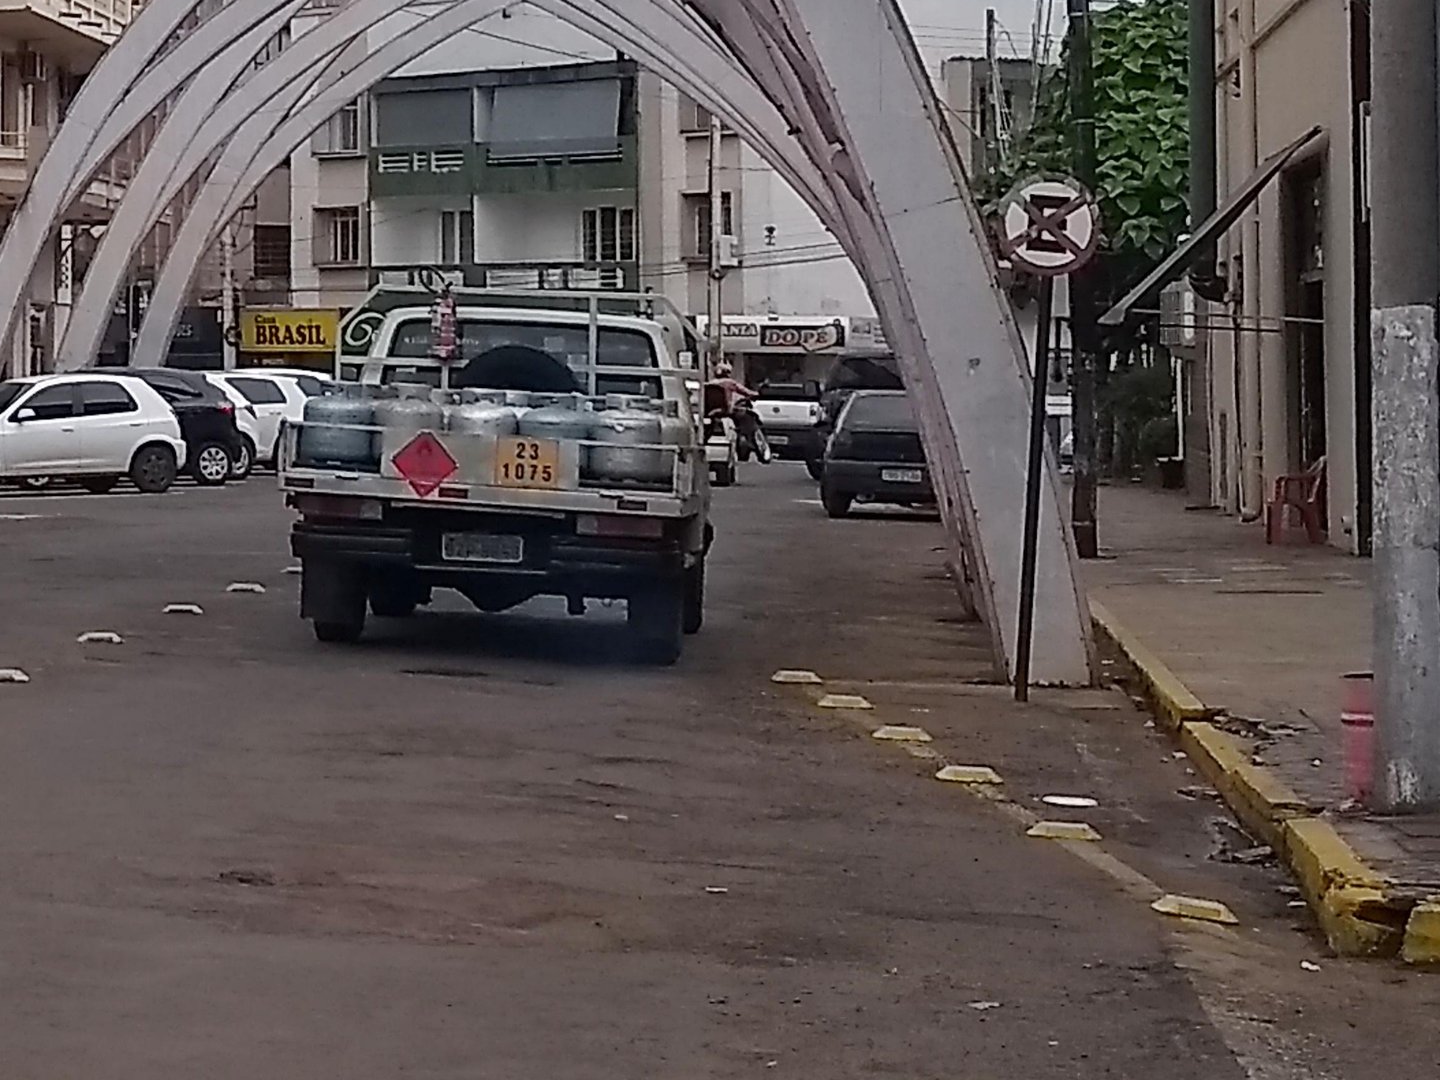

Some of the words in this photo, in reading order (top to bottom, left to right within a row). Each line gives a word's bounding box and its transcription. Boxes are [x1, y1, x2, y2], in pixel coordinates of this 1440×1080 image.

[766, 329, 799, 346] DO
[516, 442, 540, 461] 23
[502, 462, 553, 483] 1075
